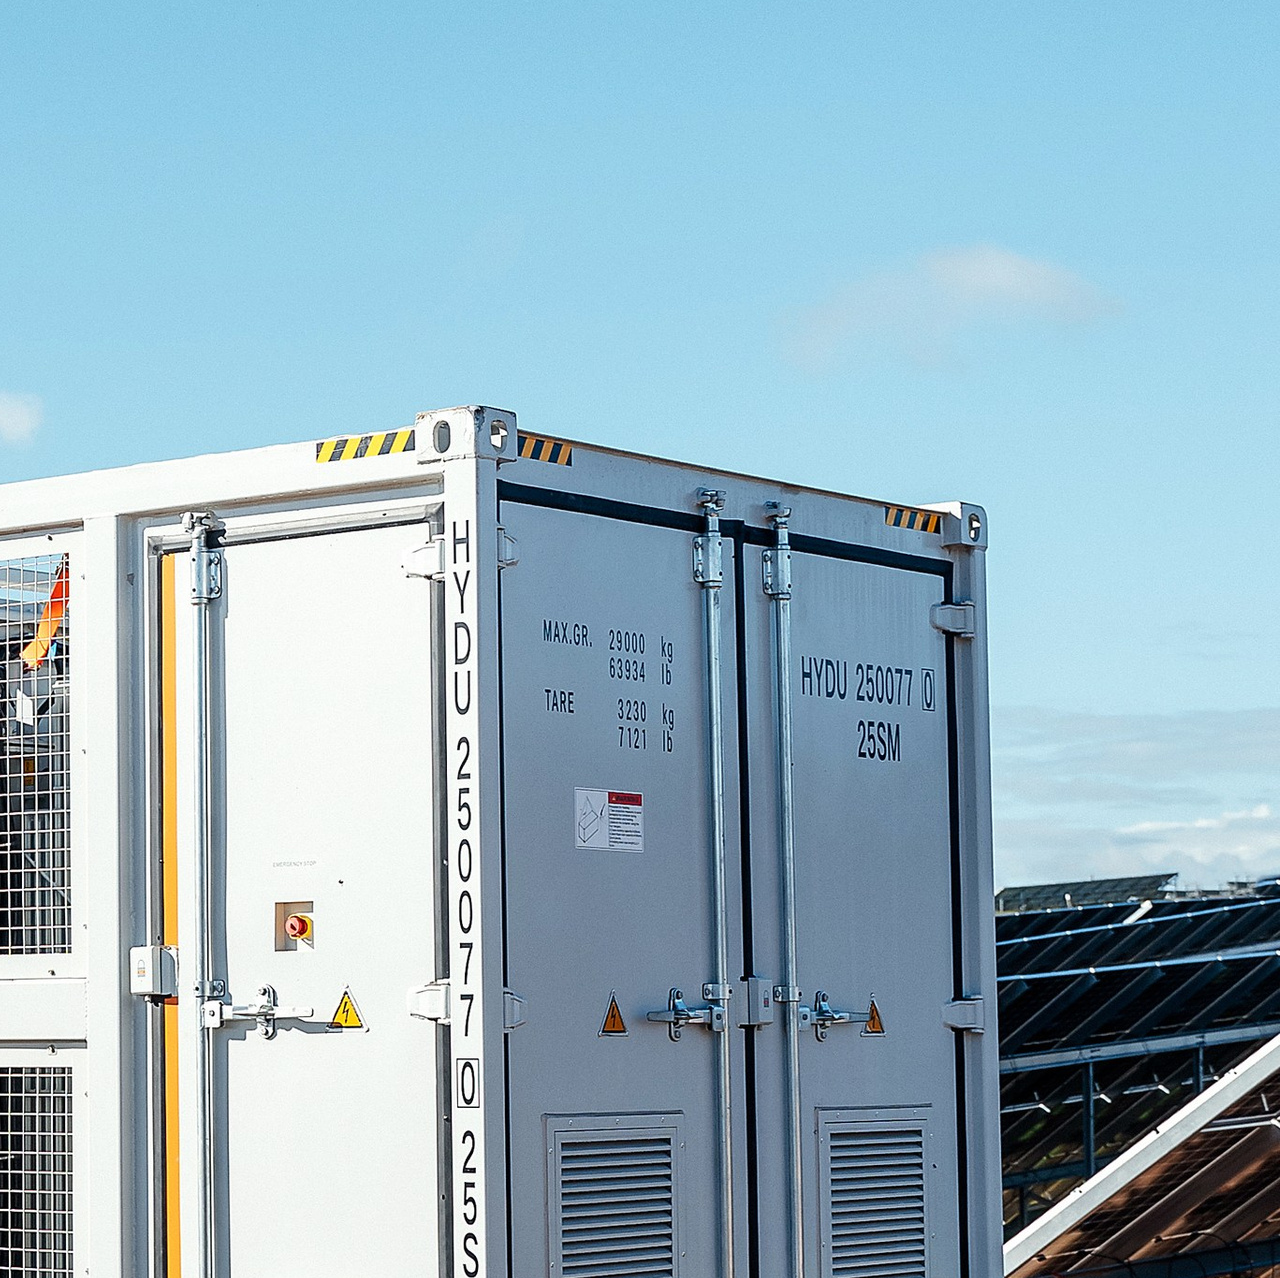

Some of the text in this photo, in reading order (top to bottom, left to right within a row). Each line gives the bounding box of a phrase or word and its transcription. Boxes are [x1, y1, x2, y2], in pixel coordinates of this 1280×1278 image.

[453, 520, 471, 715] HYDU
[543, 619, 673, 663] MAX.GR. 29000 kg
[609, 657, 672, 685] 63934 lb
[801, 656, 934, 710] HYDU 250077 0
[544, 689, 674, 730] TARE 3230 kg
[618, 726, 673, 752] 7121 lb
[857, 720, 901, 762] 25SM
[457, 736, 474, 1037] 250077
[460, 1060, 477, 1106] 0
